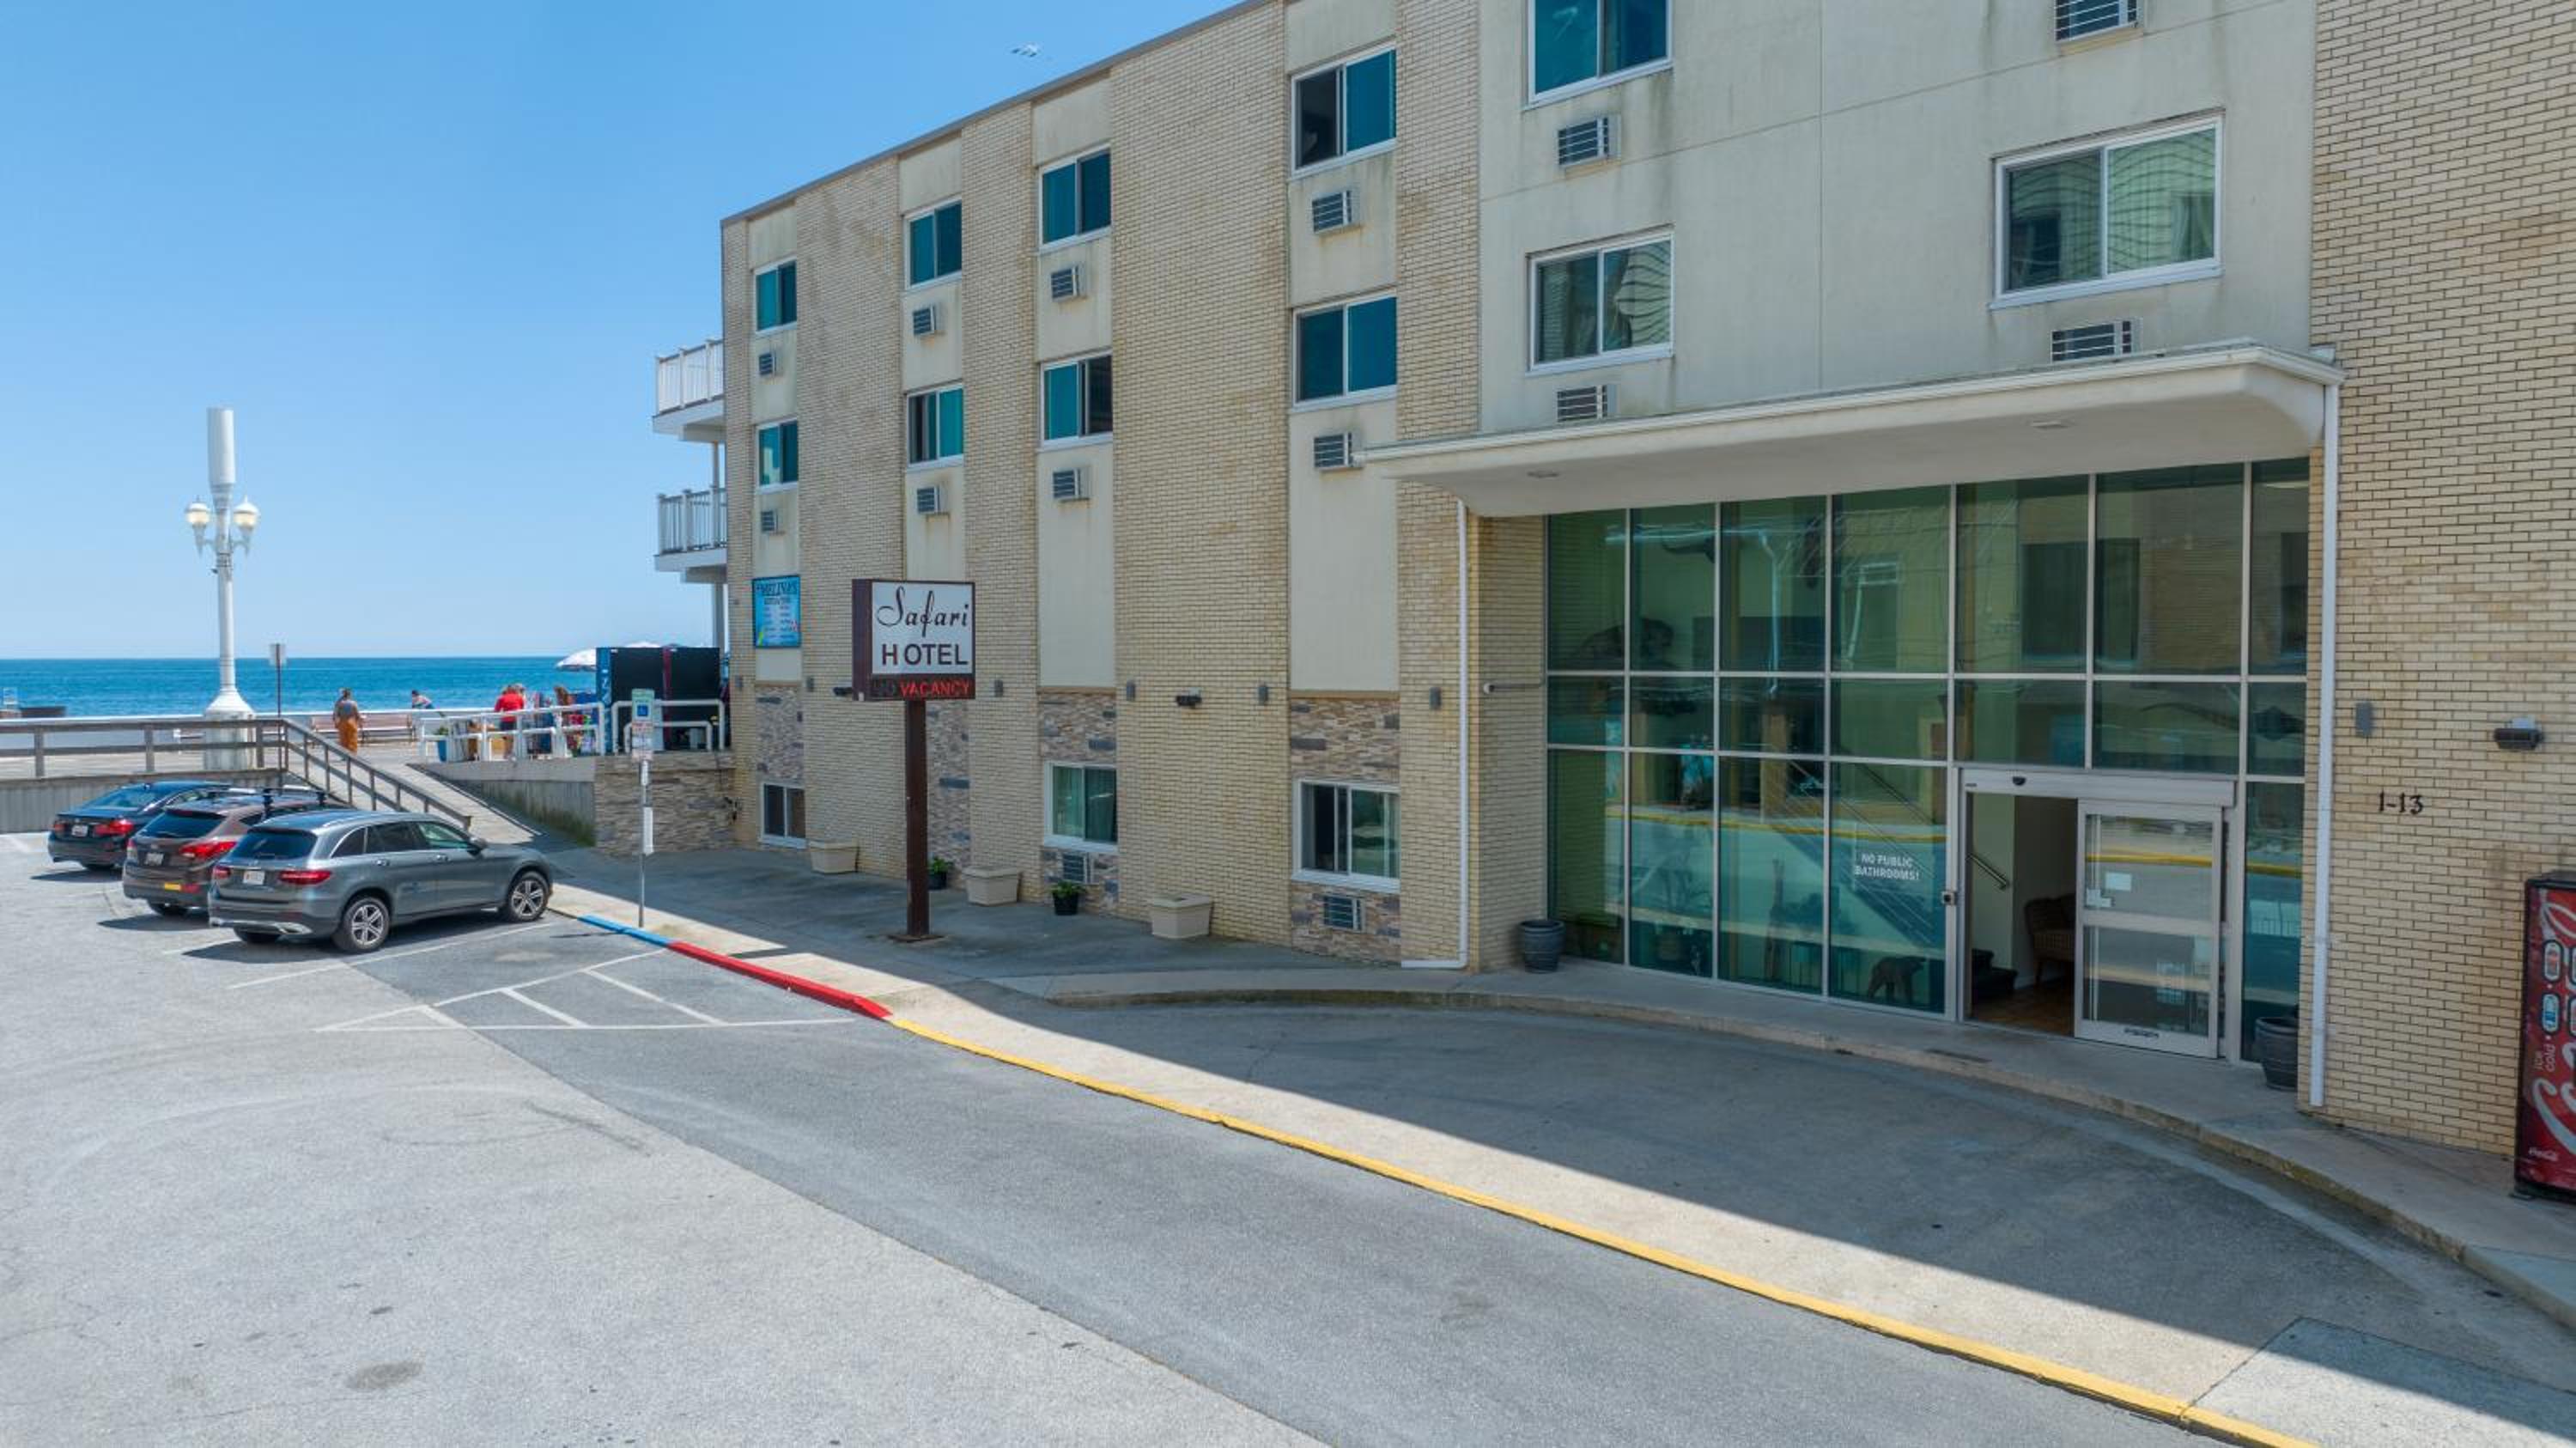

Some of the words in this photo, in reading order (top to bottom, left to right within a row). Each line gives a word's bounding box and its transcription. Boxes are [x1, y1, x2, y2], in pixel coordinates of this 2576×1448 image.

[877, 586, 969, 637] Safari
[881, 643, 969, 666] HOTEL
[900, 680, 969, 697] VACANCY
[2379, 792, 2423, 815] 1-13
[1862, 853, 1875, 865] NO
[1876, 855, 1914, 867] PUBLIC
[1854, 865, 1919, 879] BATHROOMS!
